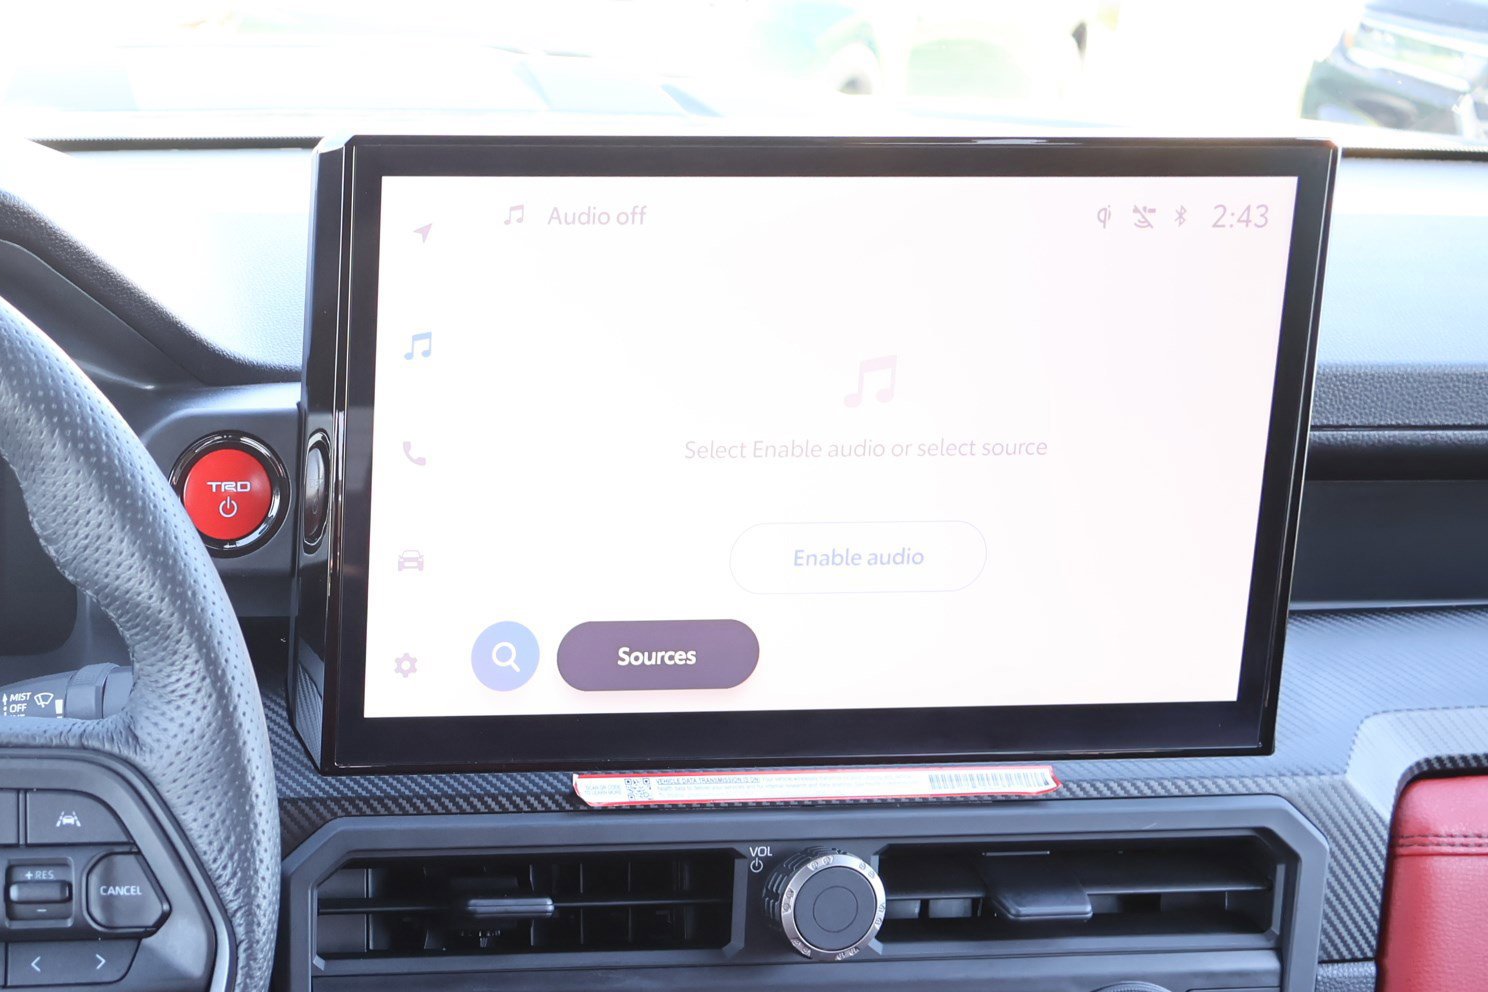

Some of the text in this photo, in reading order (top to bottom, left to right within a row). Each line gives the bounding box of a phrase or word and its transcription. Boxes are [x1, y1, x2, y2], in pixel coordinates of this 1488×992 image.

[547, 204, 648, 226] Audio off
[1211, 203, 1270, 229] 2:43
[684, 437, 1048, 460] Select Enable audio or select source
[206, 481, 251, 493] TRD
[793, 546, 925, 567] Enable audio
[617, 646, 697, 667] Sources
[10, 692, 32, 702] MIST
[9, 703, 27, 713] OFF
[749, 846, 773, 857] VOL
[100, 885, 142, 897] CANCEL
